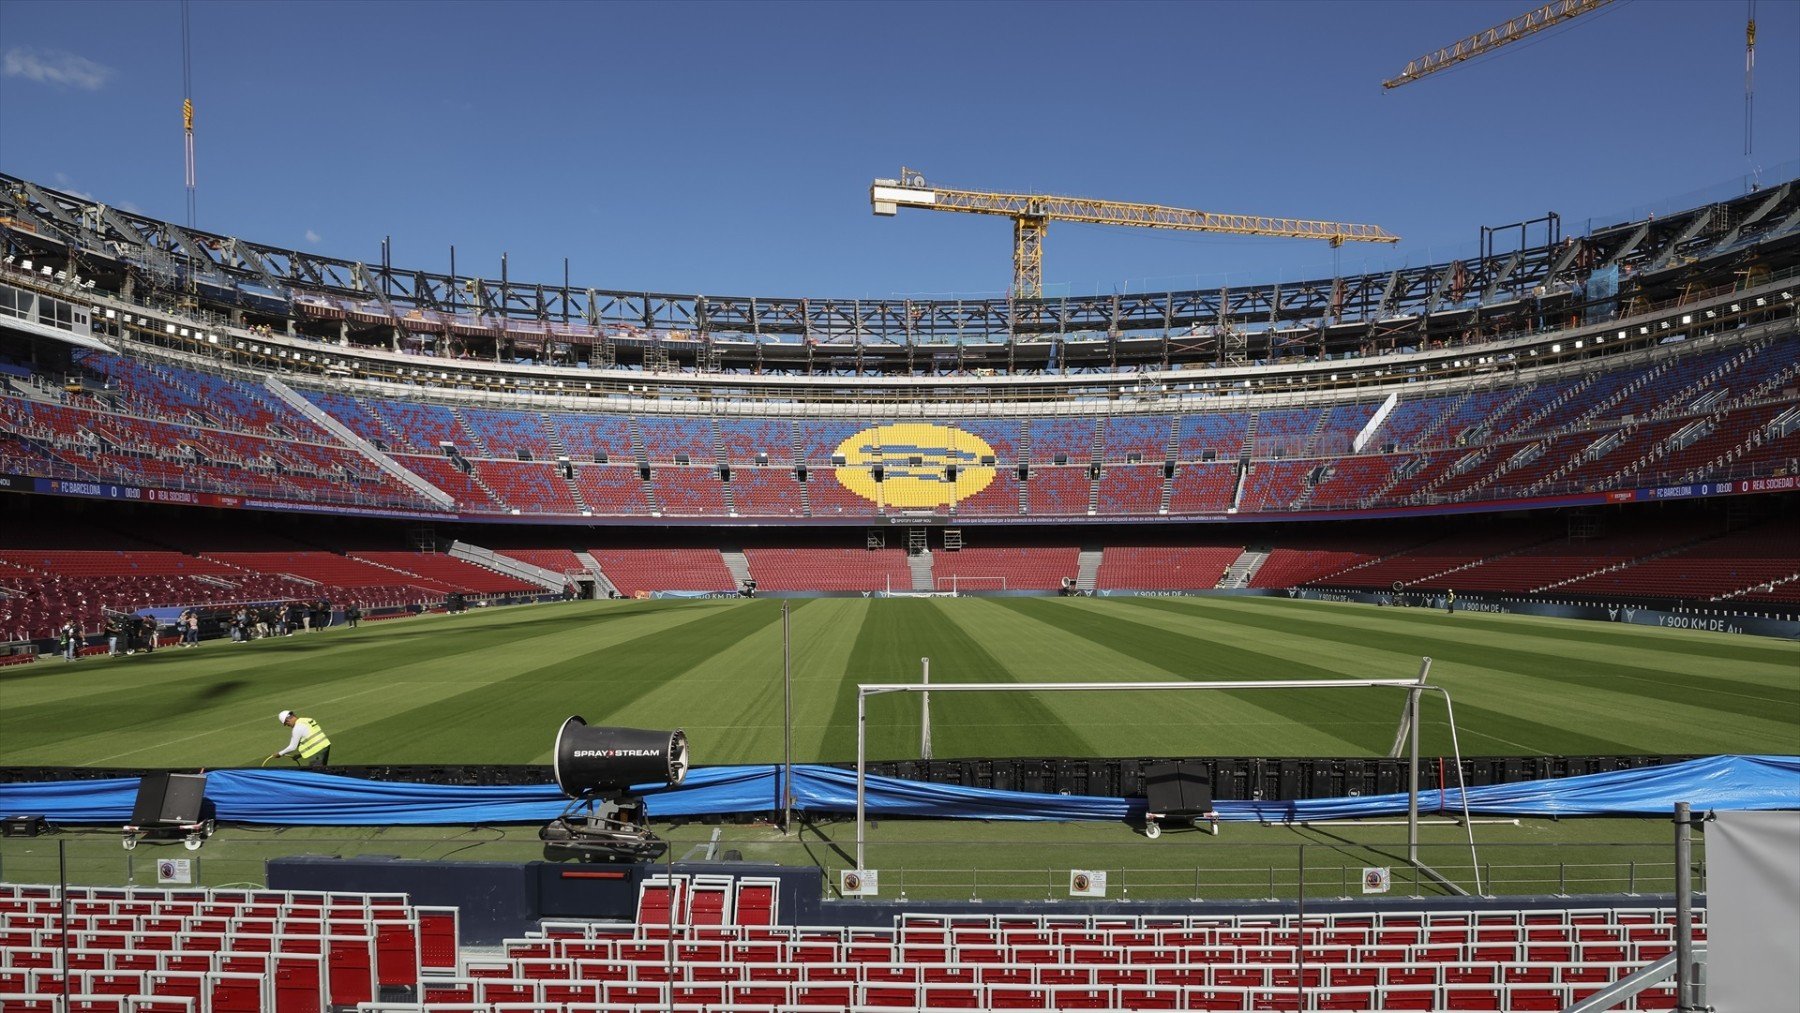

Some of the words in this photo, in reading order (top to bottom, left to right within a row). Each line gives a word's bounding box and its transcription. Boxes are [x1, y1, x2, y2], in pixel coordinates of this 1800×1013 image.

[61, 482, 68, 493] FC
[70, 482, 101, 495] BARCELONA
[111, 486, 118, 498] 0
[125, 488, 140, 498] 00:00
[149, 490, 155, 500] 0
[158, 490, 169, 500] REAL
[170, 491, 191, 502] SOCIEDAD
[1657, 487, 1664, 498] FC
[1664, 486, 1692, 496] BARCELONA
[1702, 484, 1708, 494] 0
[1716, 482, 1732, 493] 00:00
[1742, 481, 1748, 492] 0
[1752, 480, 1766, 490] REAL
[1766, 478, 1794, 489] SOCIEDAD
[1480, 603, 1490, 611] KM
[1490, 604, 1500, 612] DE
[1658, 616, 1666, 626] Y
[1667, 616, 1689, 628] 900
[1691, 618, 1707, 630] KM
[1710, 619, 1724, 632] DE
